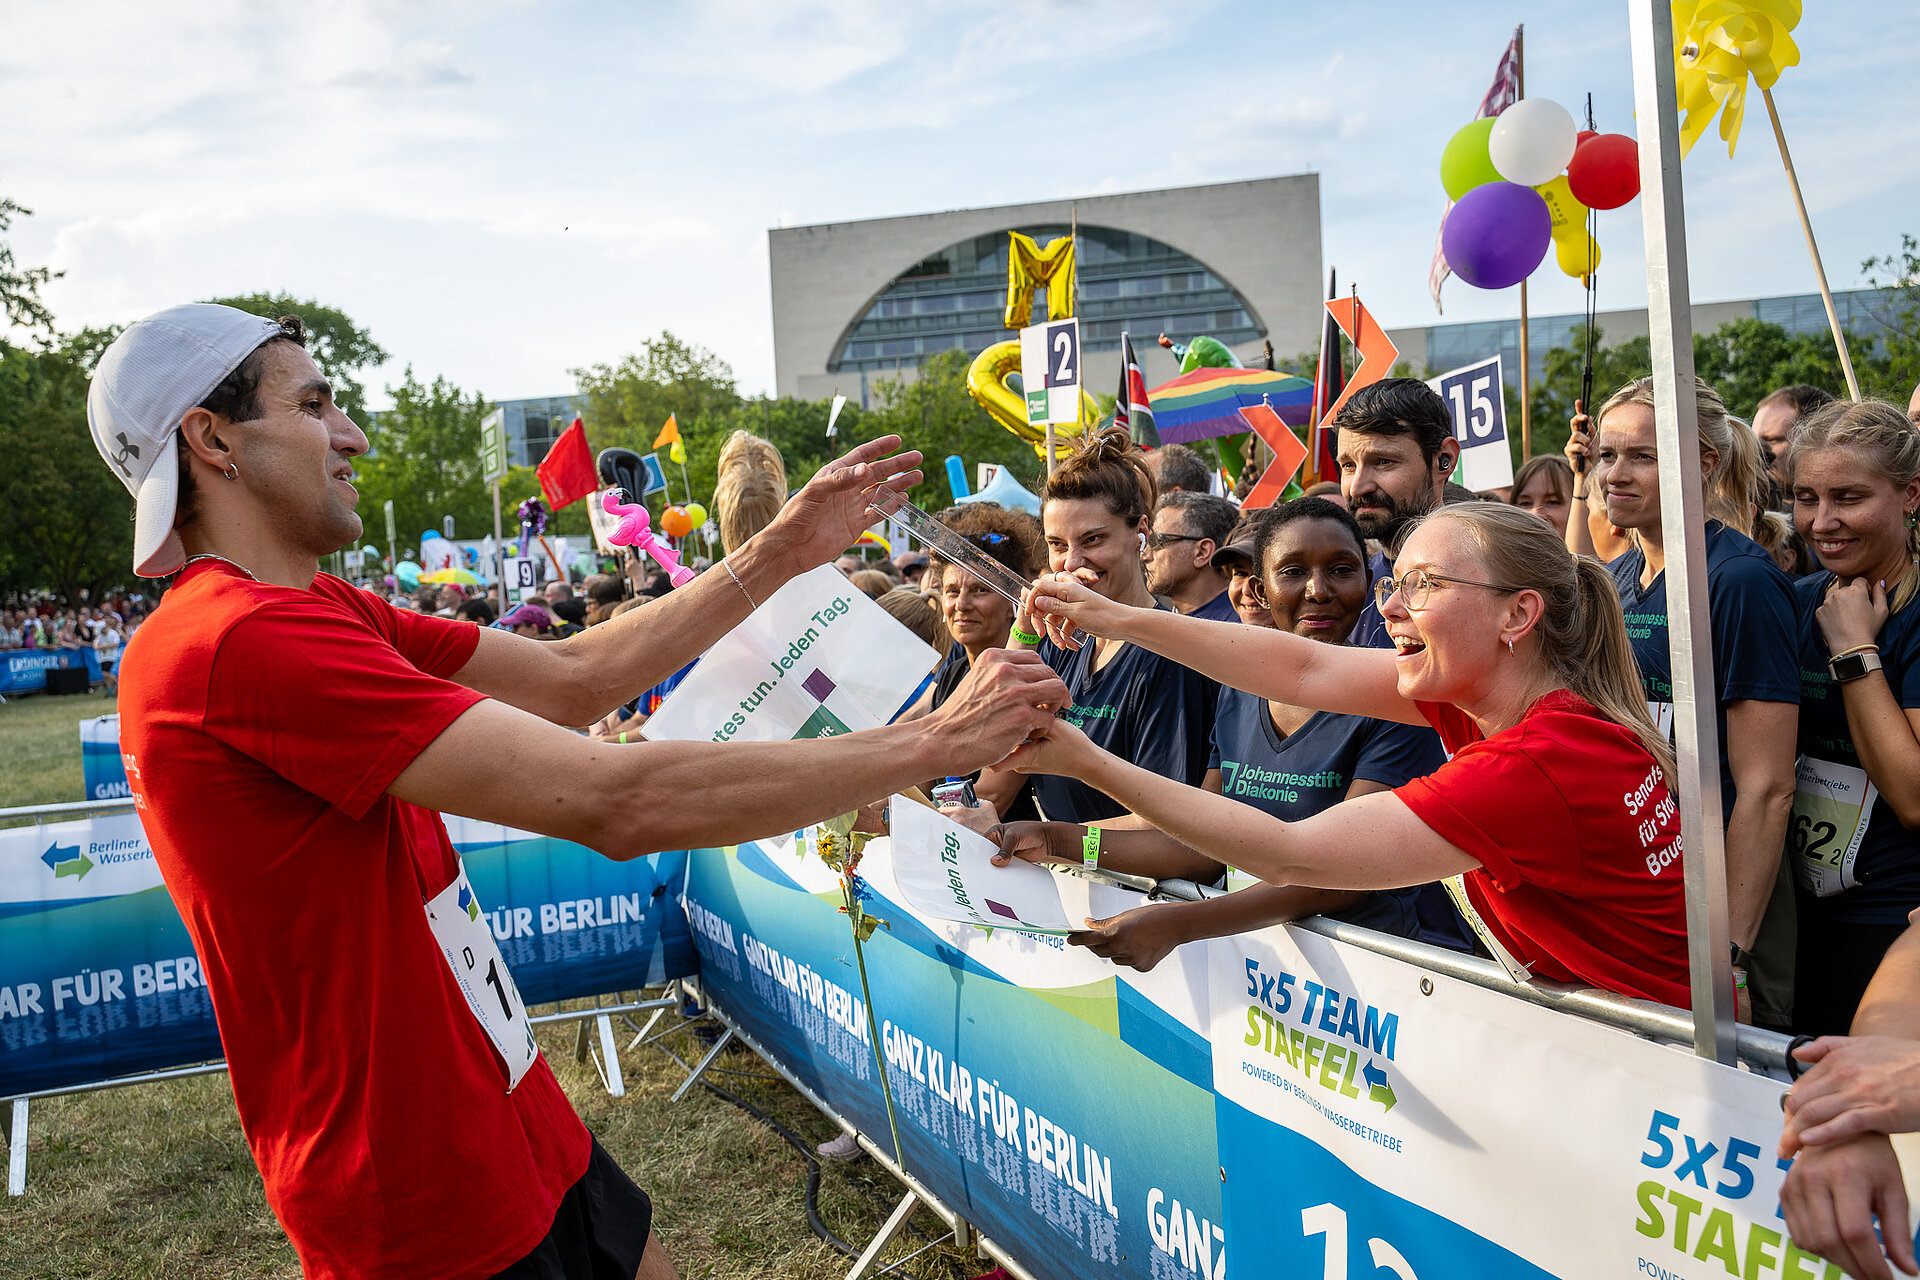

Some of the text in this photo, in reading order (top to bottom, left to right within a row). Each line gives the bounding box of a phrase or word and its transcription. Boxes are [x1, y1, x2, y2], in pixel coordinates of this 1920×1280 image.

[1054, 331, 1073, 381] 2
[1449, 375, 1494, 442] 15
[520, 562, 532, 586] 9
[739, 679, 778, 715] tun.
[770, 625, 820, 678] Jeden
[811, 595, 852, 629] Tag.
[1235, 779, 1299, 803] Diakonie
[1238, 763, 1343, 788] Johannesstift
[1624, 765, 1663, 816] Senats
[89, 838, 141, 855] Berliner
[941, 832, 961, 866] Tag.
[1638, 818, 1659, 848] für
[1830, 848, 1842, 866] 2
[540, 892, 646, 936] BERLIN.
[462, 946, 475, 971] D
[52, 968, 126, 1011] FÜR
[742, 933, 871, 1047] GANZ KLAR FÜR BERLIN.
[1245, 957, 1399, 1061] 5x5 TEAM
[1244, 1005, 1360, 1100] STAFFEL
[882, 1019, 1119, 1220] GANZ KLAR FÜR BERLIN.
[1242, 1061, 1282, 1088] POWERED
[1283, 1079, 1293, 1093] BY
[1322, 1105, 1402, 1154] WASSERBETRIEBE
[1640, 1109, 1761, 1200] 5x5
